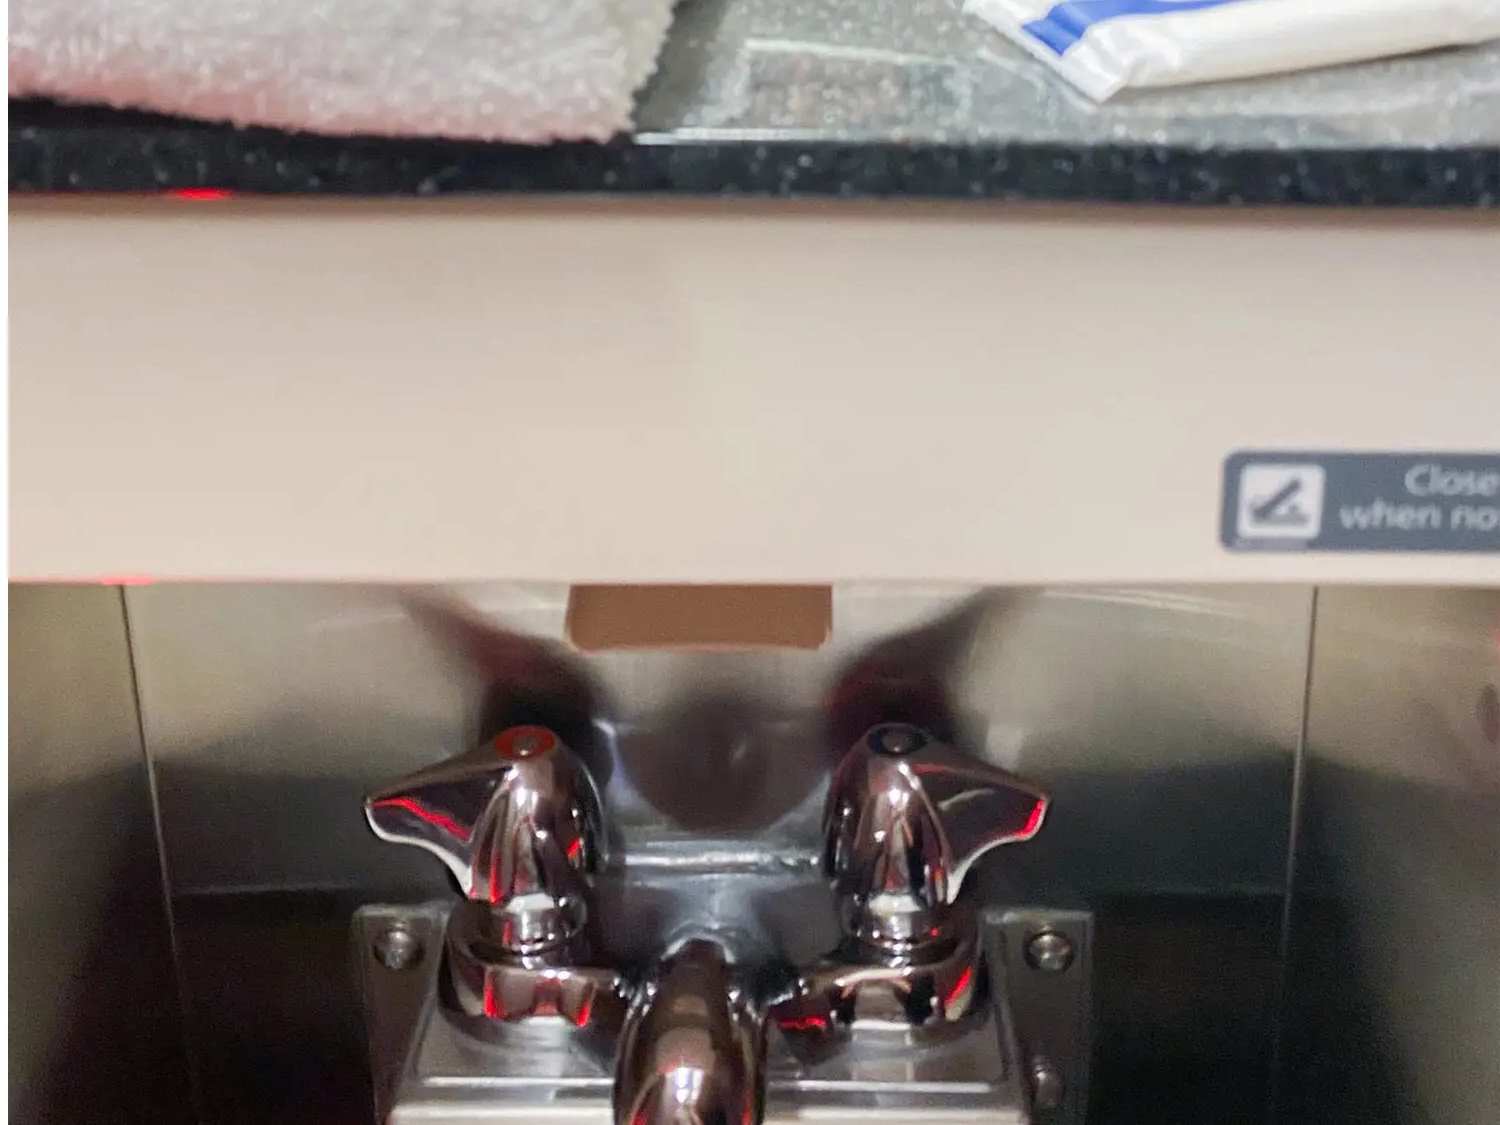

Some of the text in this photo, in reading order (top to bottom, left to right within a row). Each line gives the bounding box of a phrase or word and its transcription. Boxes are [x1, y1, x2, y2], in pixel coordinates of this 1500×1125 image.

[1404, 464, 1500, 496] Close
[1339, 496, 1500, 531] when no
